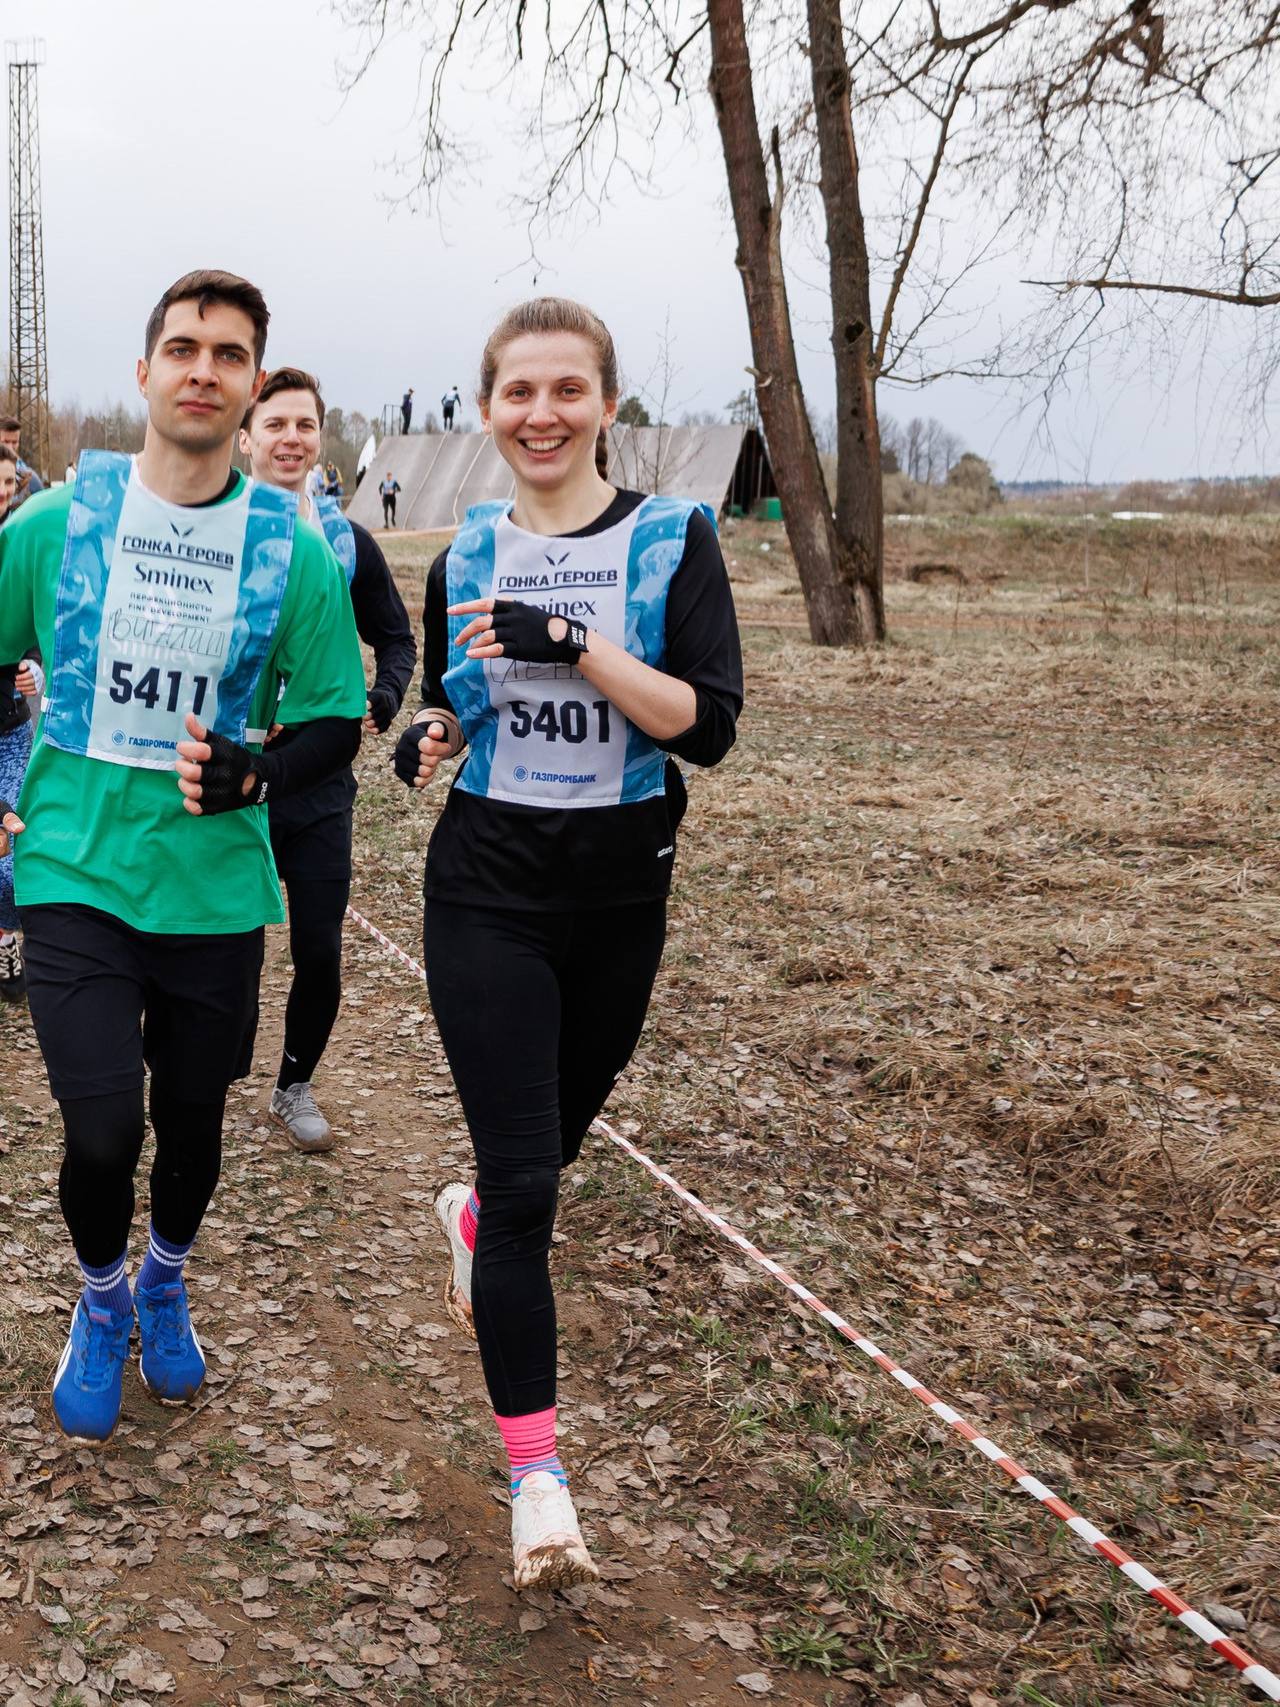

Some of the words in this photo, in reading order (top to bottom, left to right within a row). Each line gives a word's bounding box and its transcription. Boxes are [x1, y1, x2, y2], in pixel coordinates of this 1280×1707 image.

[122, 535, 172, 554] ГОНКА
[178, 543, 234, 565] ГЕРОЕВ
[134, 561, 214, 595] Sminex
[499, 575, 549, 588] ГОНКА
[554, 570, 618, 584] ГЕРОЕВ
[128, 602, 146, 612] FINE
[150, 607, 210, 623] DEVELOPMENT
[130, 592, 212, 612] ПЕРФЕКЦИОНИСТЫ
[517, 597, 596, 617] inex
[110, 660, 208, 716] 5411
[507, 701, 610, 743] 5401
[531, 772, 597, 783] ГАЗПРОМБАНК
